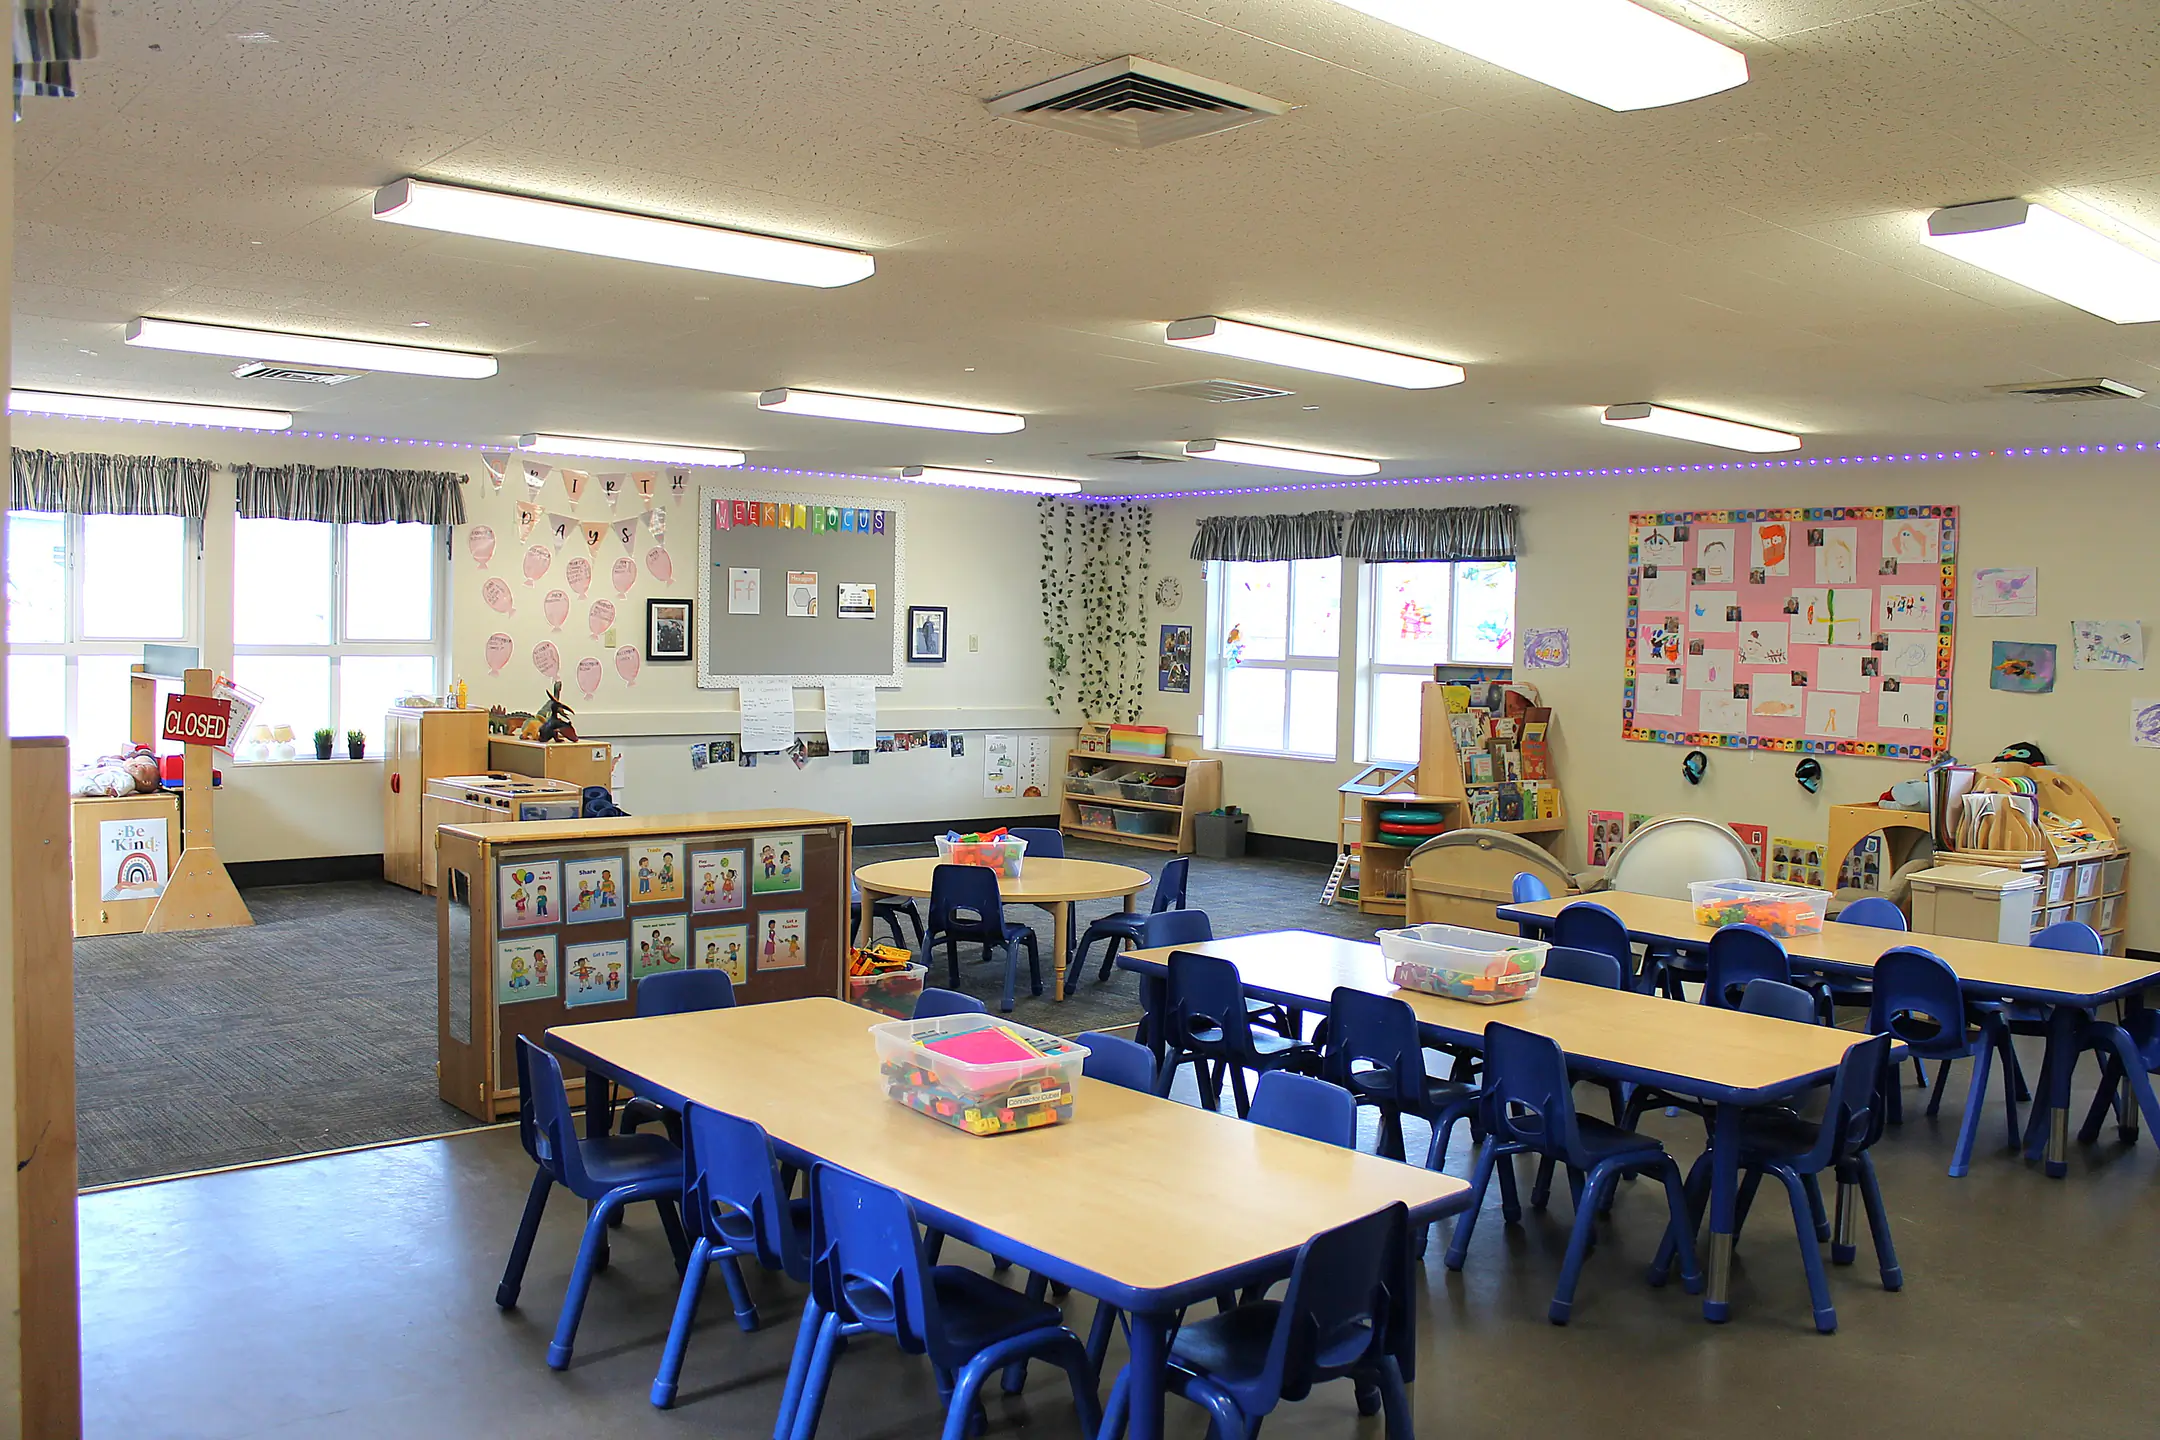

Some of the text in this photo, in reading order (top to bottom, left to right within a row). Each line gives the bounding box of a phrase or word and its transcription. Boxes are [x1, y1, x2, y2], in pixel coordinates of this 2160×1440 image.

[716, 503, 885, 529] WEEKL FOCUS
[790, 574, 815, 583] Hexagon
[733, 579, 756, 601] Ff
[165, 710, 226, 739] CLOSED
[124, 824, 145, 838] Be
[111, 836, 156, 852] Kind
[1009, 1095, 1041, 1106] Connector
